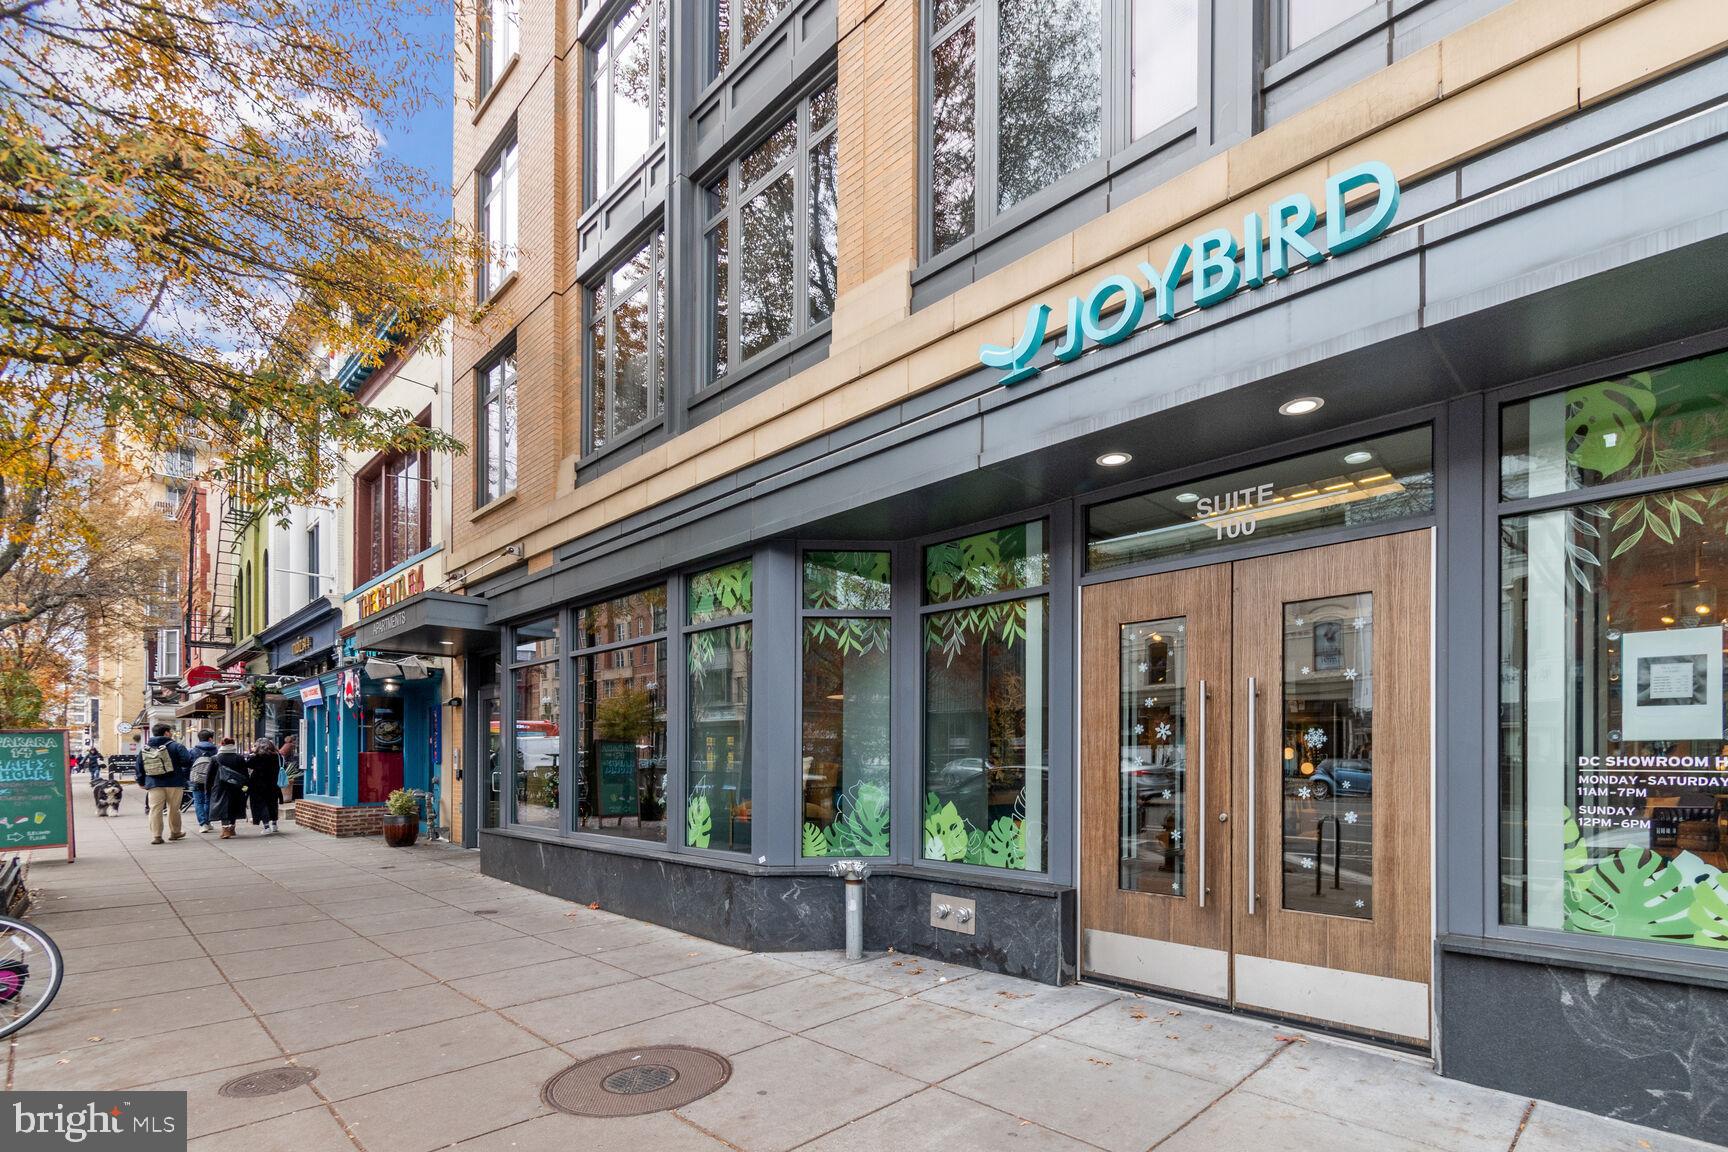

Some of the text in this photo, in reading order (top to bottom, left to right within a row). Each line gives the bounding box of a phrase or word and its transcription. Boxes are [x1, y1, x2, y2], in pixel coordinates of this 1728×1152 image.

[1052, 160, 1401, 363] JOYBIRD
[1196, 482, 1274, 518] SUITE
[1215, 516, 1256, 541] 100
[372, 610, 407, 636] APARTMENTS
[0, 736, 58, 748] AKARA
[10, 747, 33, 759] 14
[1578, 756, 1601, 767] DC
[1605, 756, 1709, 767] SHOWROOM
[1577, 787, 1648, 798] 11AM-7PM
[1578, 805, 1636, 816] SUNDAY
[1578, 817, 1651, 829] 12PM-6PM
